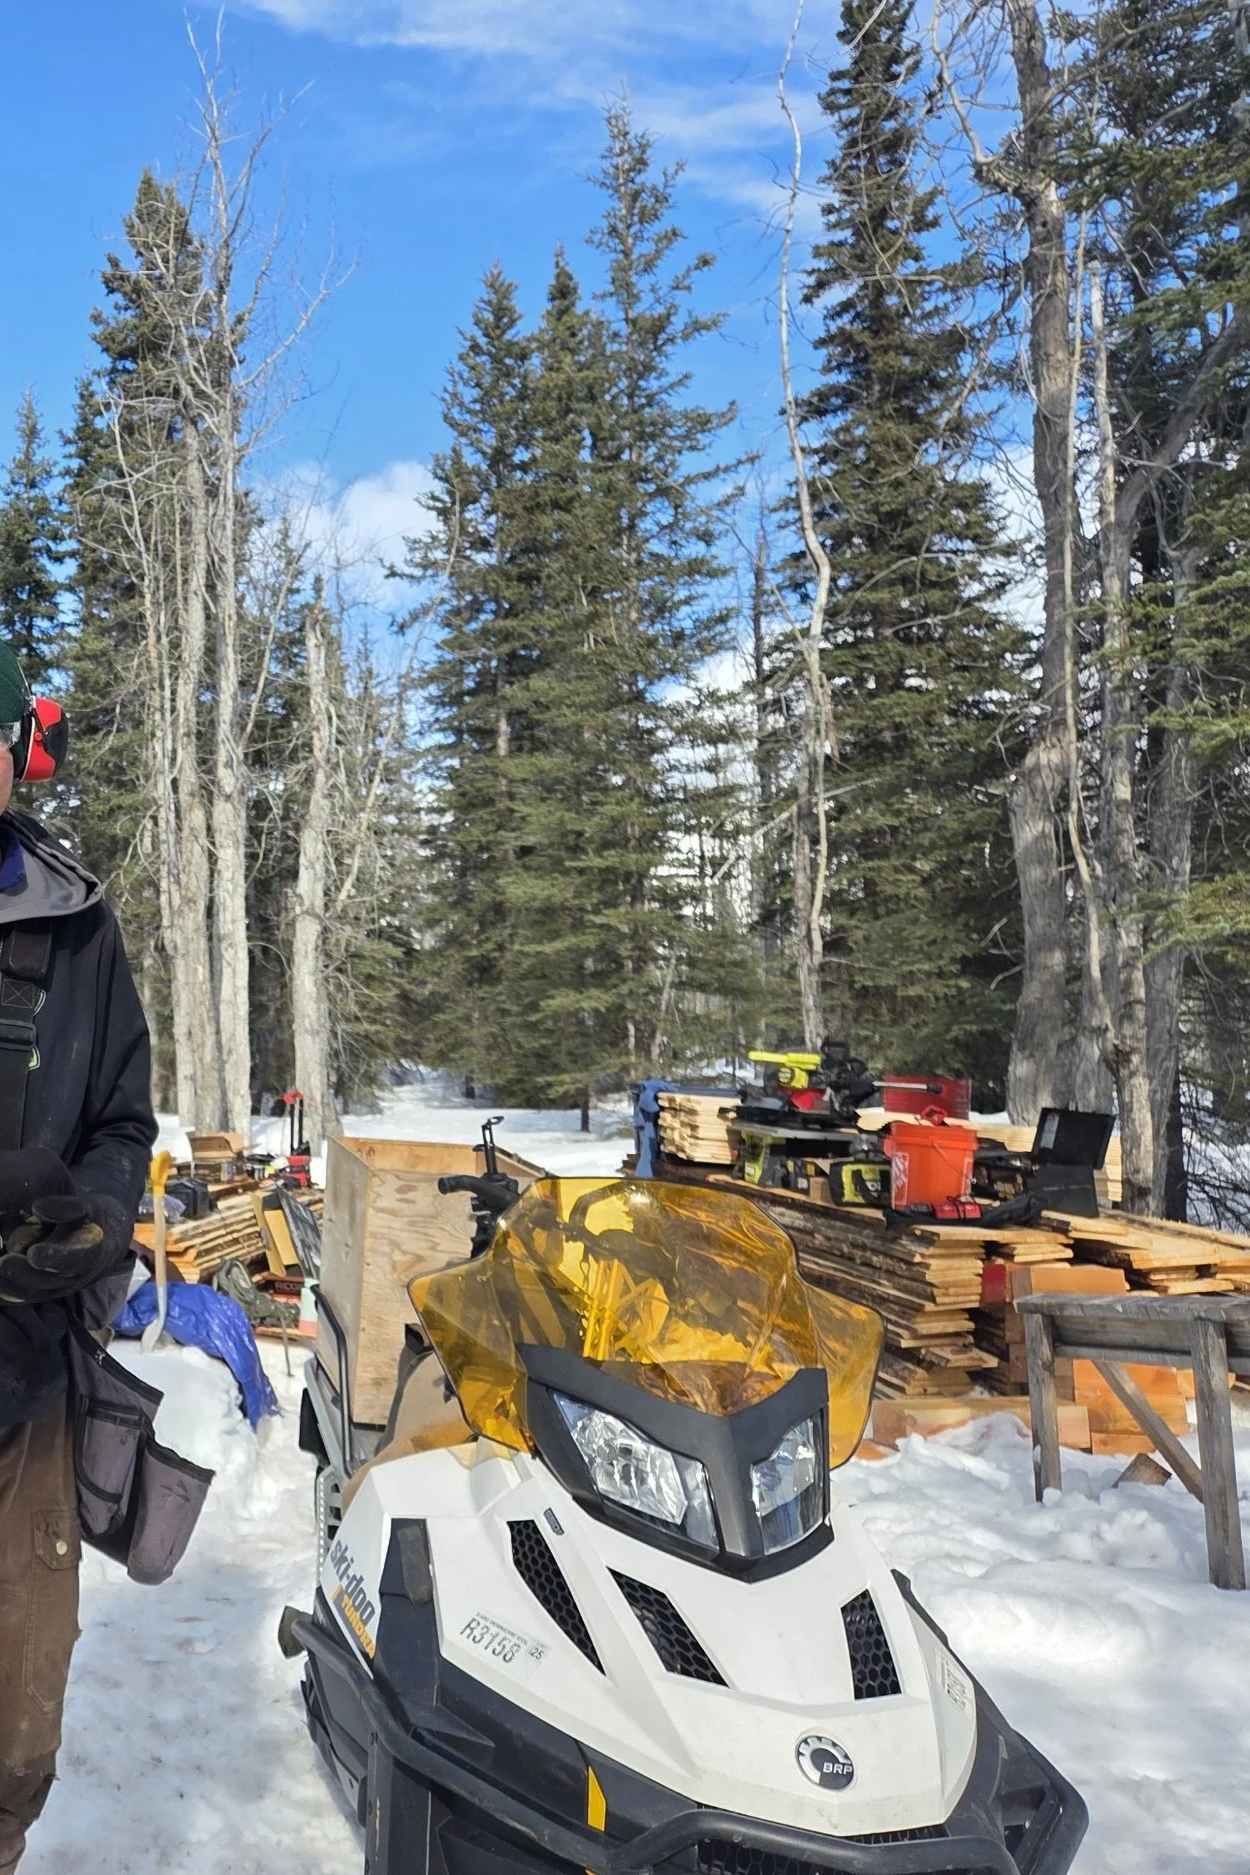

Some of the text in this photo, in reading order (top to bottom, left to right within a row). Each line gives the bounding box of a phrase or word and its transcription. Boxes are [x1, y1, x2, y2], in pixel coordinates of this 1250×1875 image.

[330, 1539, 376, 1629] ski-doo
[341, 1593, 376, 1660] TUNDRA
[529, 1647, 545, 1660] 25
[822, 1761, 853, 1775] BRP
